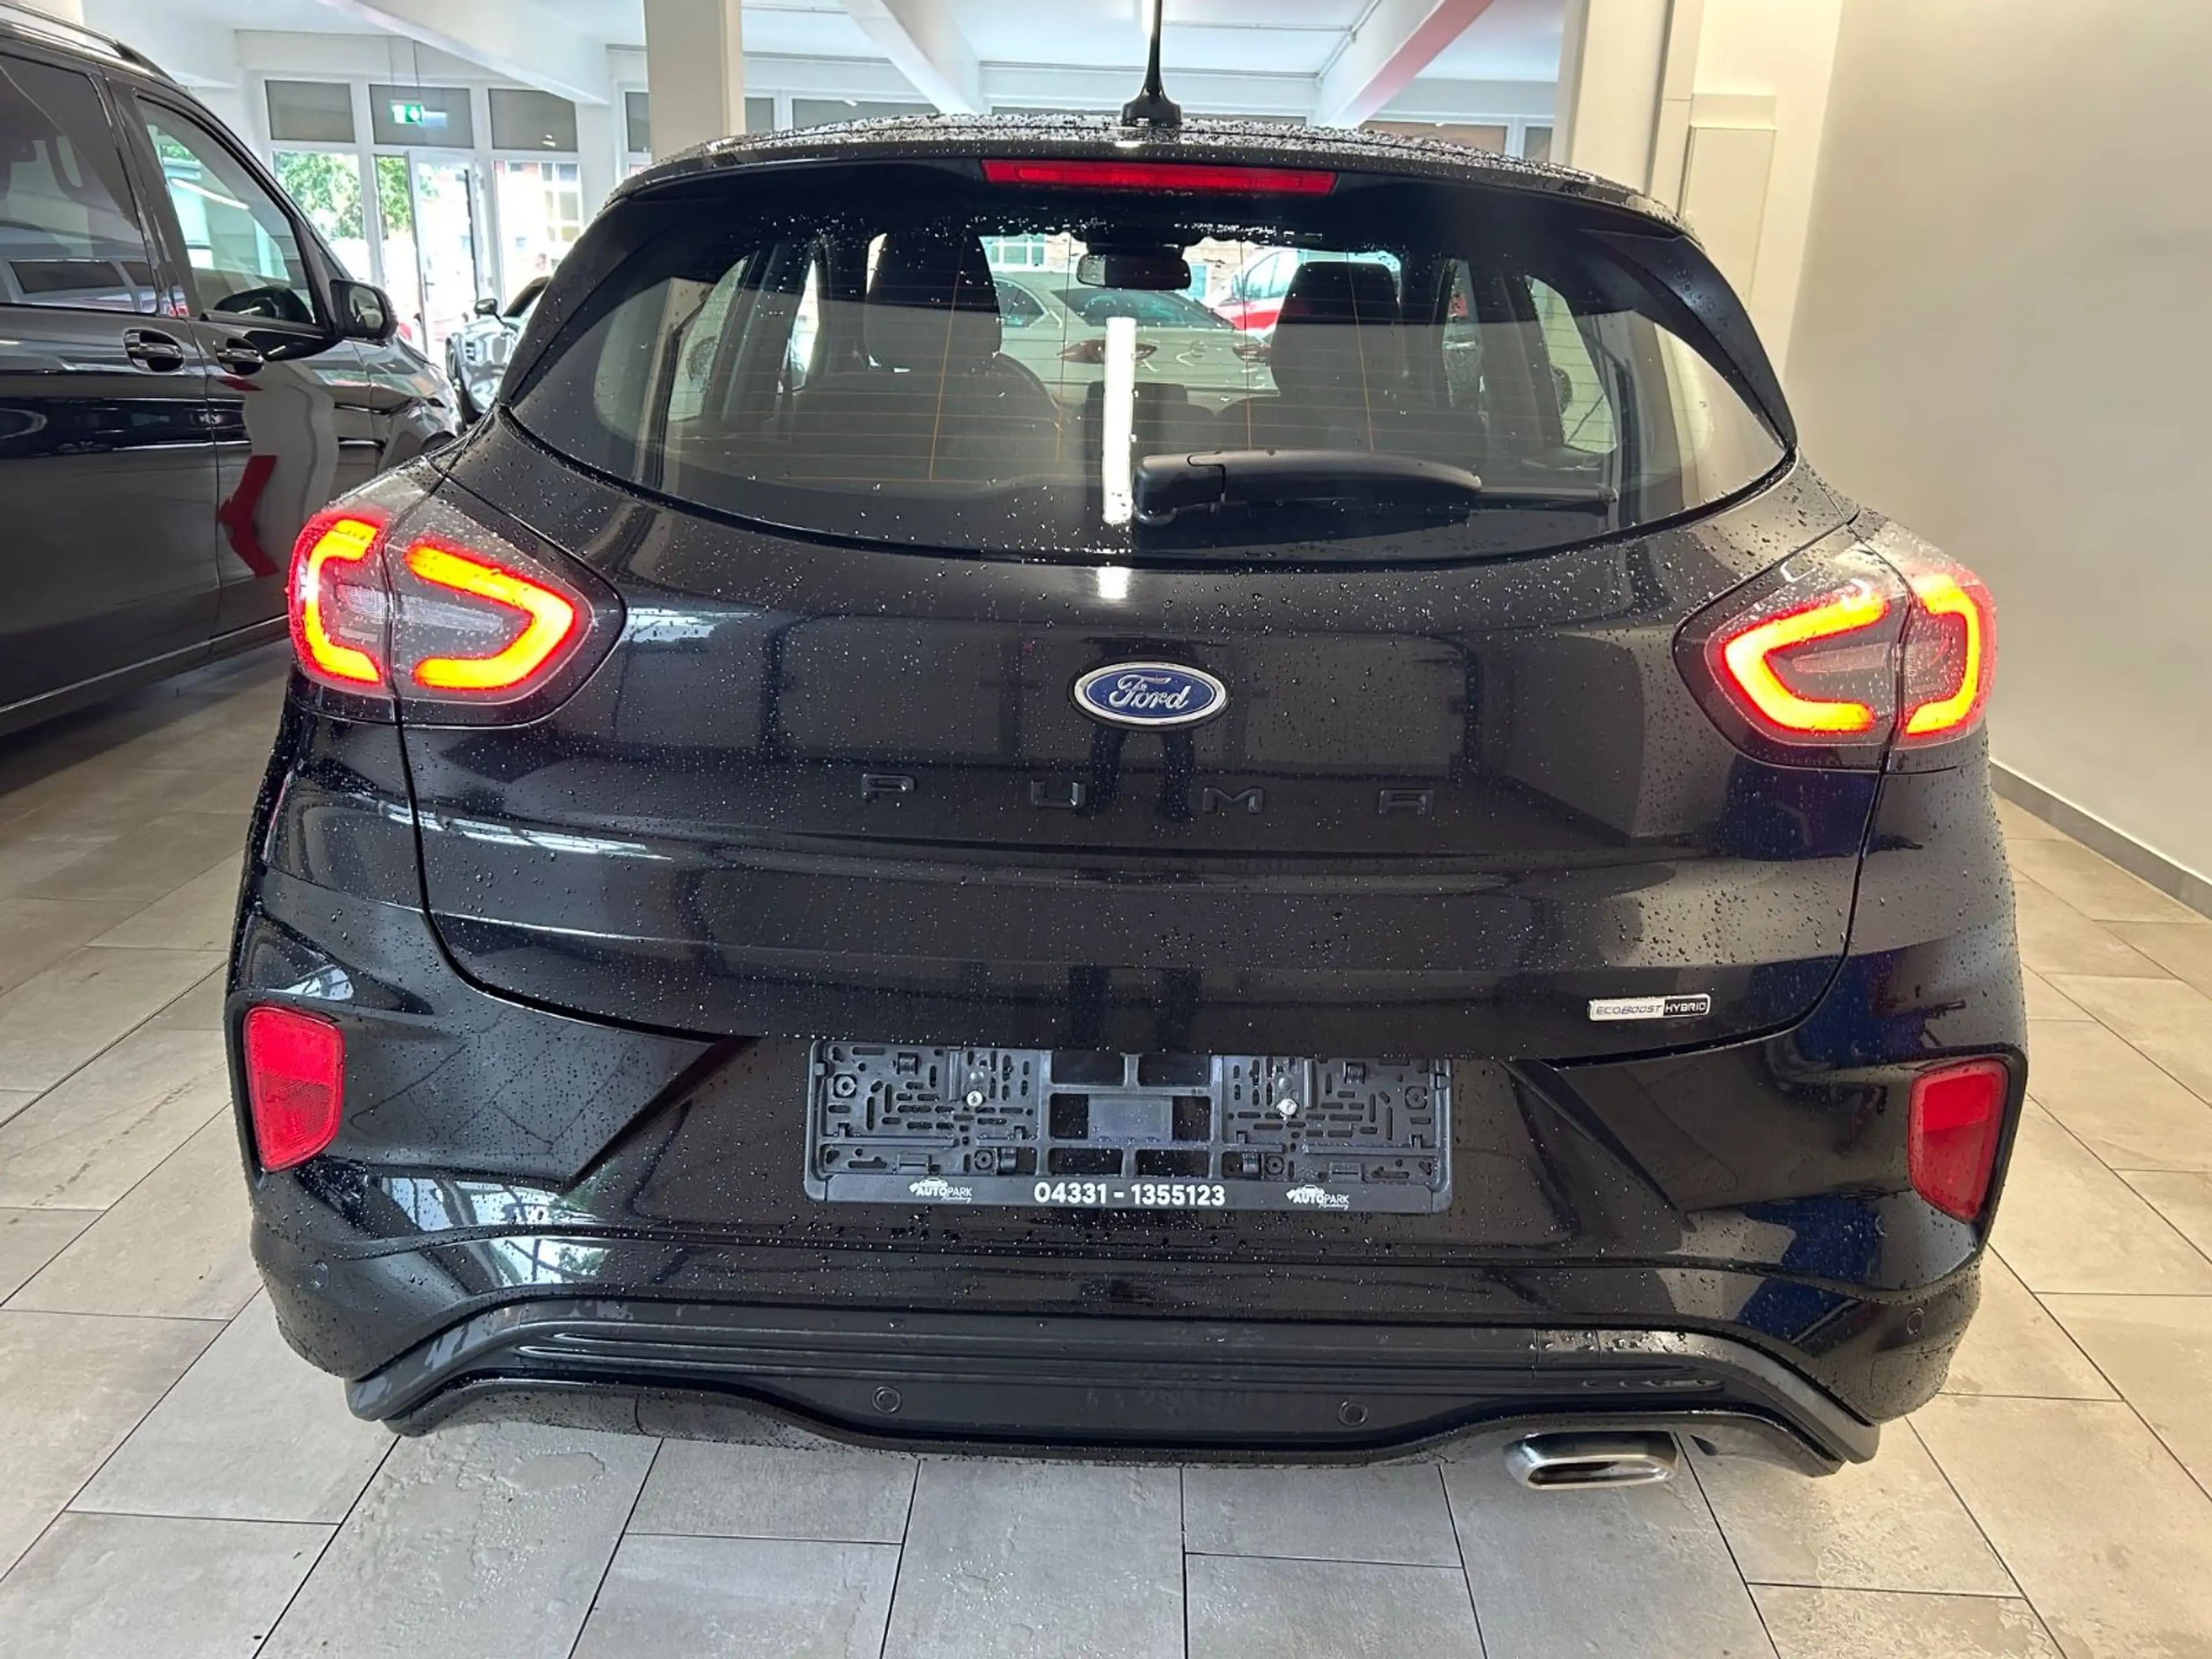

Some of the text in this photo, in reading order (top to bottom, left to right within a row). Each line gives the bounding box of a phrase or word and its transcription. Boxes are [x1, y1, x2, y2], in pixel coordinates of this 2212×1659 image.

[1109, 675, 1191, 709] Ford
[861, 772, 1435, 815] PUMA
[1596, 1002, 1706, 1014] ECOBOOST HYBRID
[1034, 1182, 1107, 1203] 04331
[1131, 1184, 1225, 1205] 1355123
